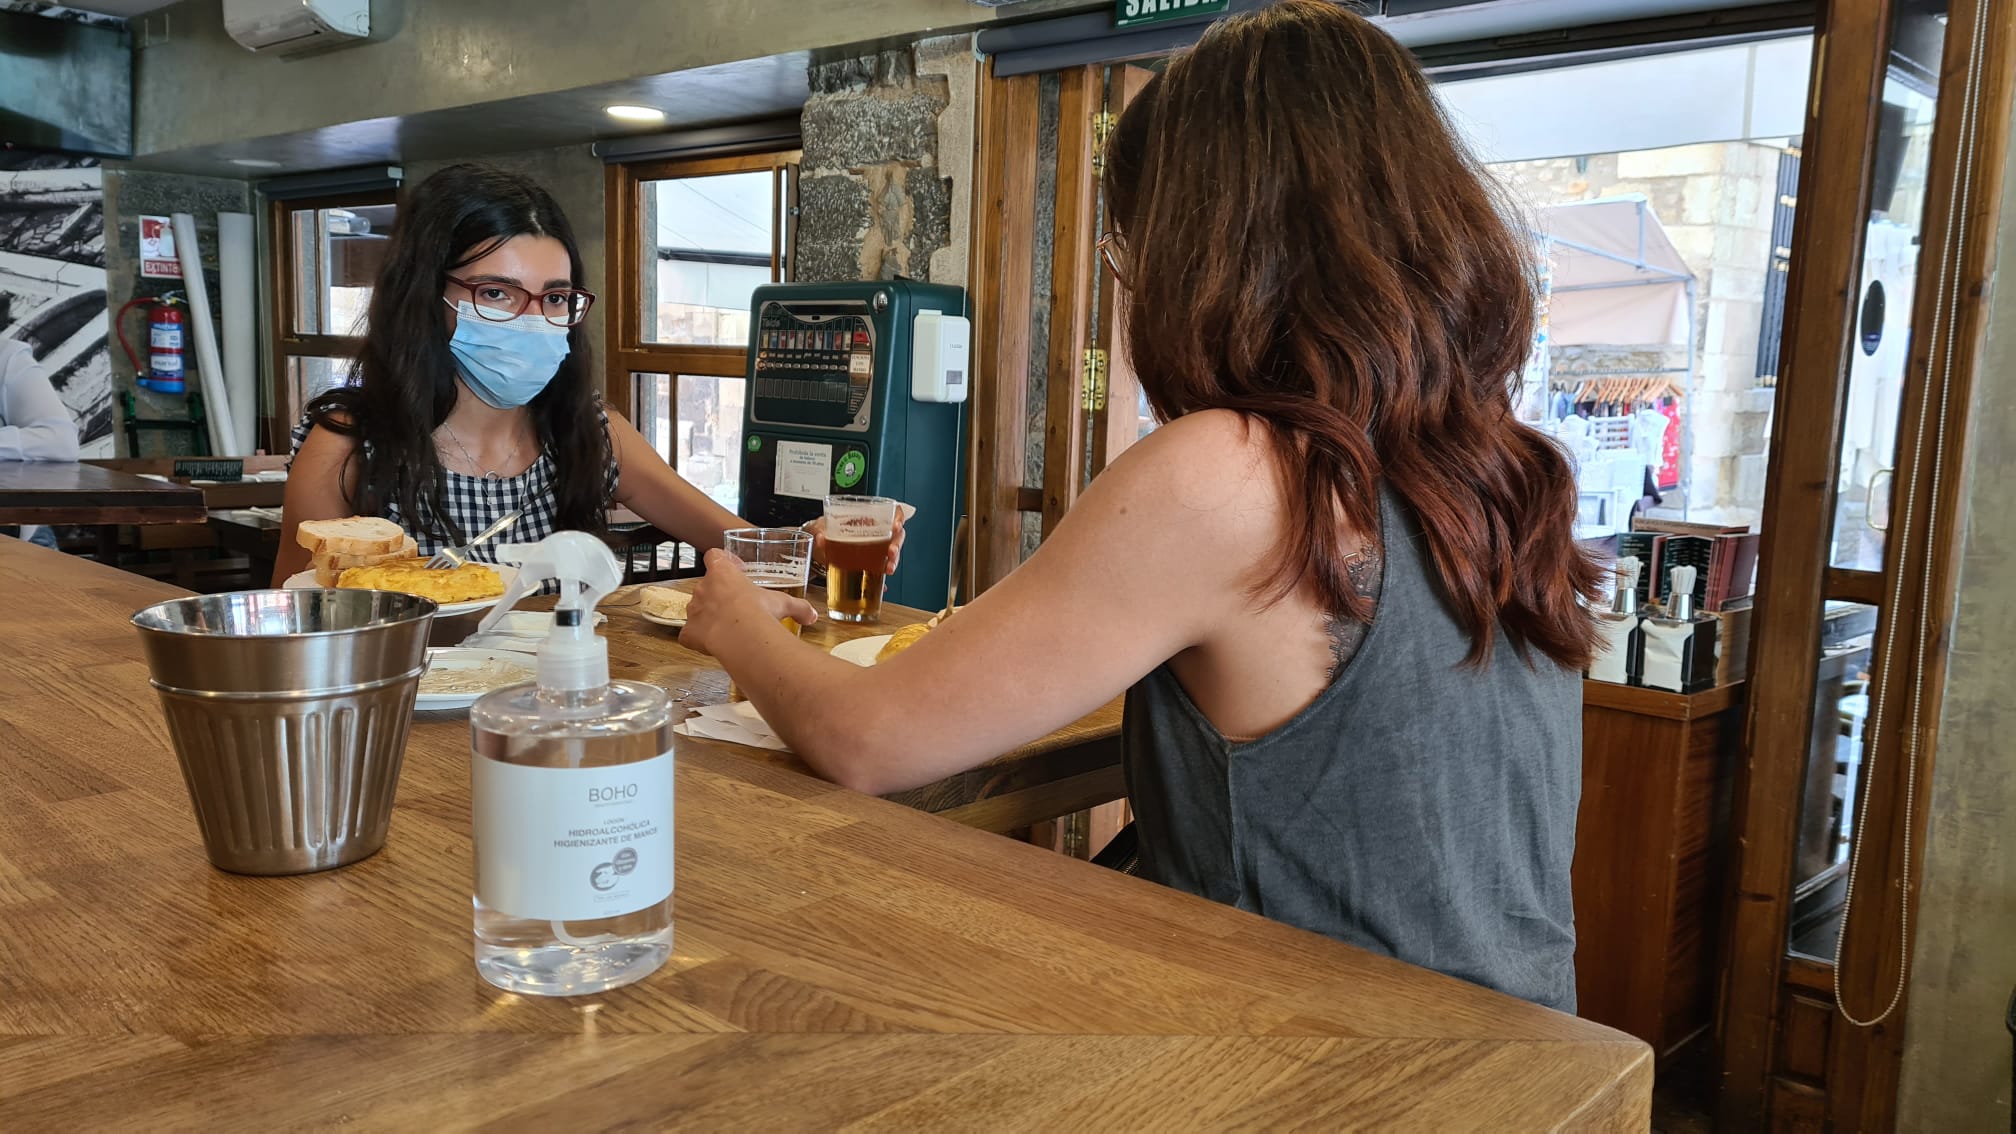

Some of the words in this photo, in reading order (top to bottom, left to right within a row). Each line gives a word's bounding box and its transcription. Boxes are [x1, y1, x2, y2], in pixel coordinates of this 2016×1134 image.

[1125, 0, 1218, 16] SAL
[145, 261, 180, 274] EXTINTO
[588, 783, 638, 802] BOHO
[553, 836, 619, 848] HIGIENIZANTE
[620, 835, 632, 843] DE
